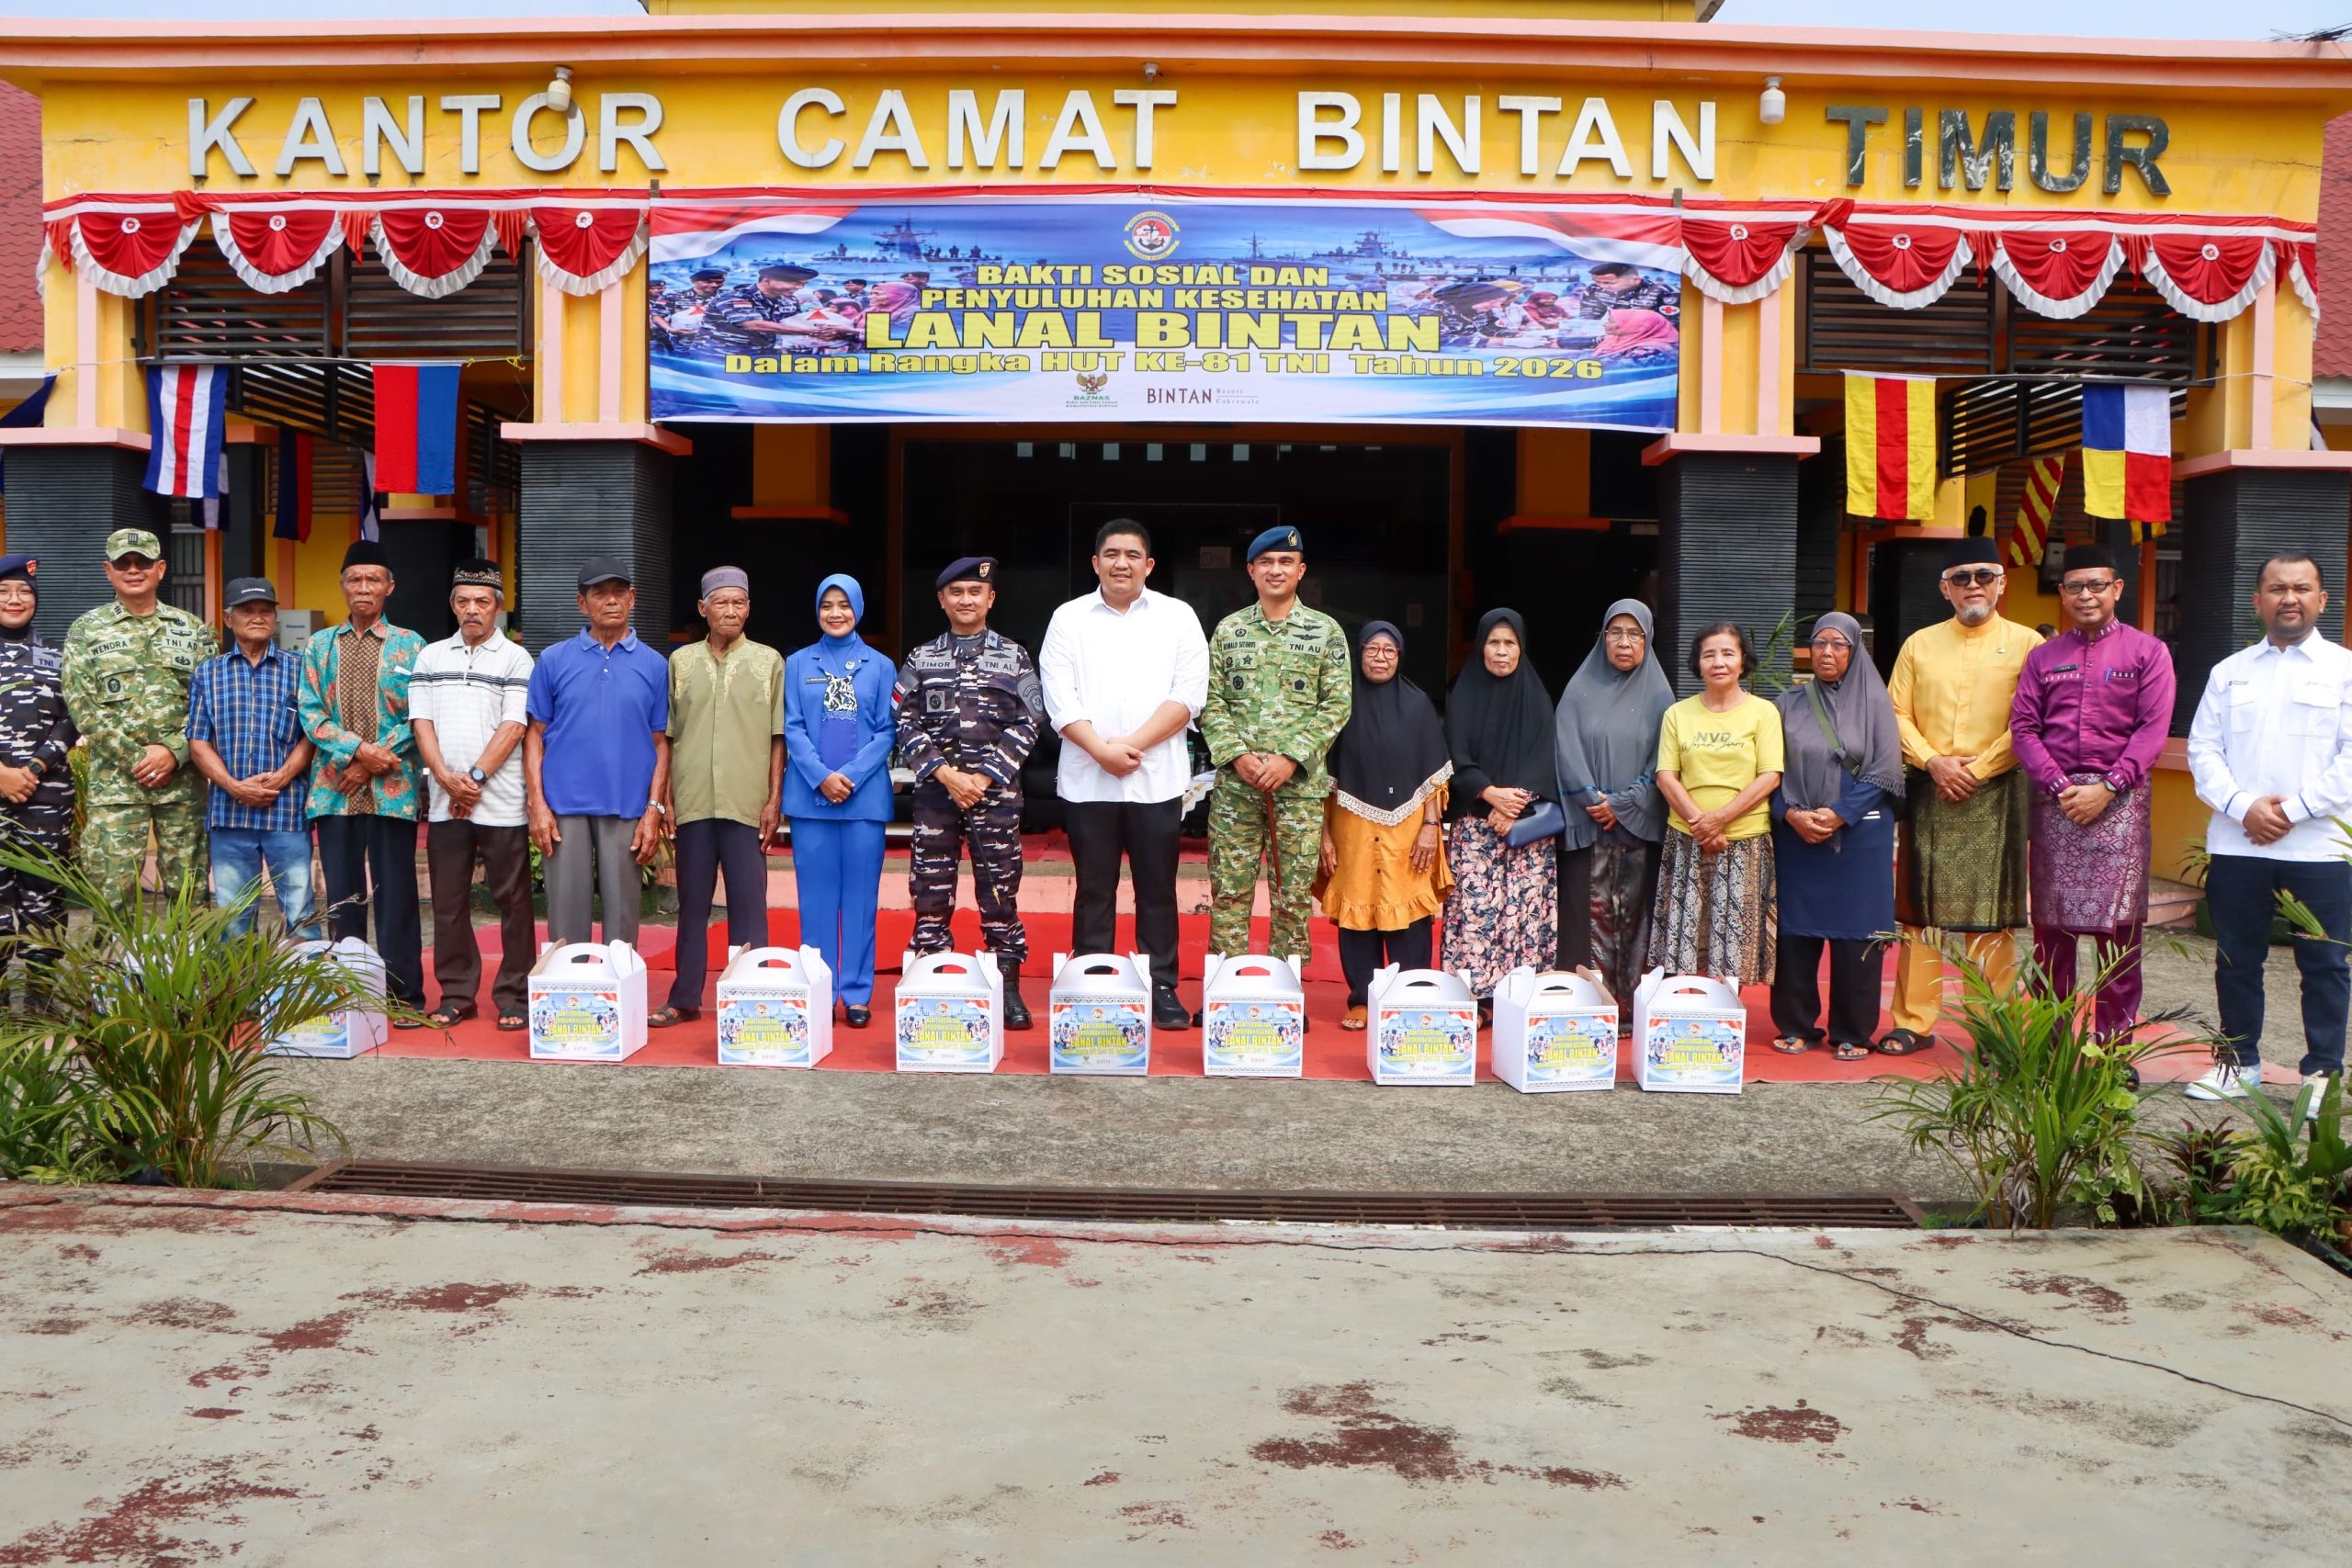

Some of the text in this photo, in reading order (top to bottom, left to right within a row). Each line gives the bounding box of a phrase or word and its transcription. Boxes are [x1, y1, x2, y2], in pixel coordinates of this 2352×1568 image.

[187, 87, 2173, 196] KANTOR CAMAT BINTAN TIMUR
[977, 265, 1329, 288] BAKTI SOSIAL DAN
[921, 288, 1387, 312] PENYULUHAN KESEHATAN
[865, 310, 1441, 353] LANAL BINTAN
[725, 352, 1604, 380] Dalam Rangka HUT KE-81 TNI Tahun 2026
[1148, 389, 1212, 403] BINTAN
[92, 640, 128, 656] WENDRA
[166, 638, 198, 651] TNI AD
[1290, 643, 1321, 653] TNI AU
[39, 658, 54, 667] TNI
[984, 660, 1014, 671] TNI AL
[1069, 1036, 1127, 1047] LANAL BINTAN
[1225, 1035, 1283, 1046] LANAL BINTAN
